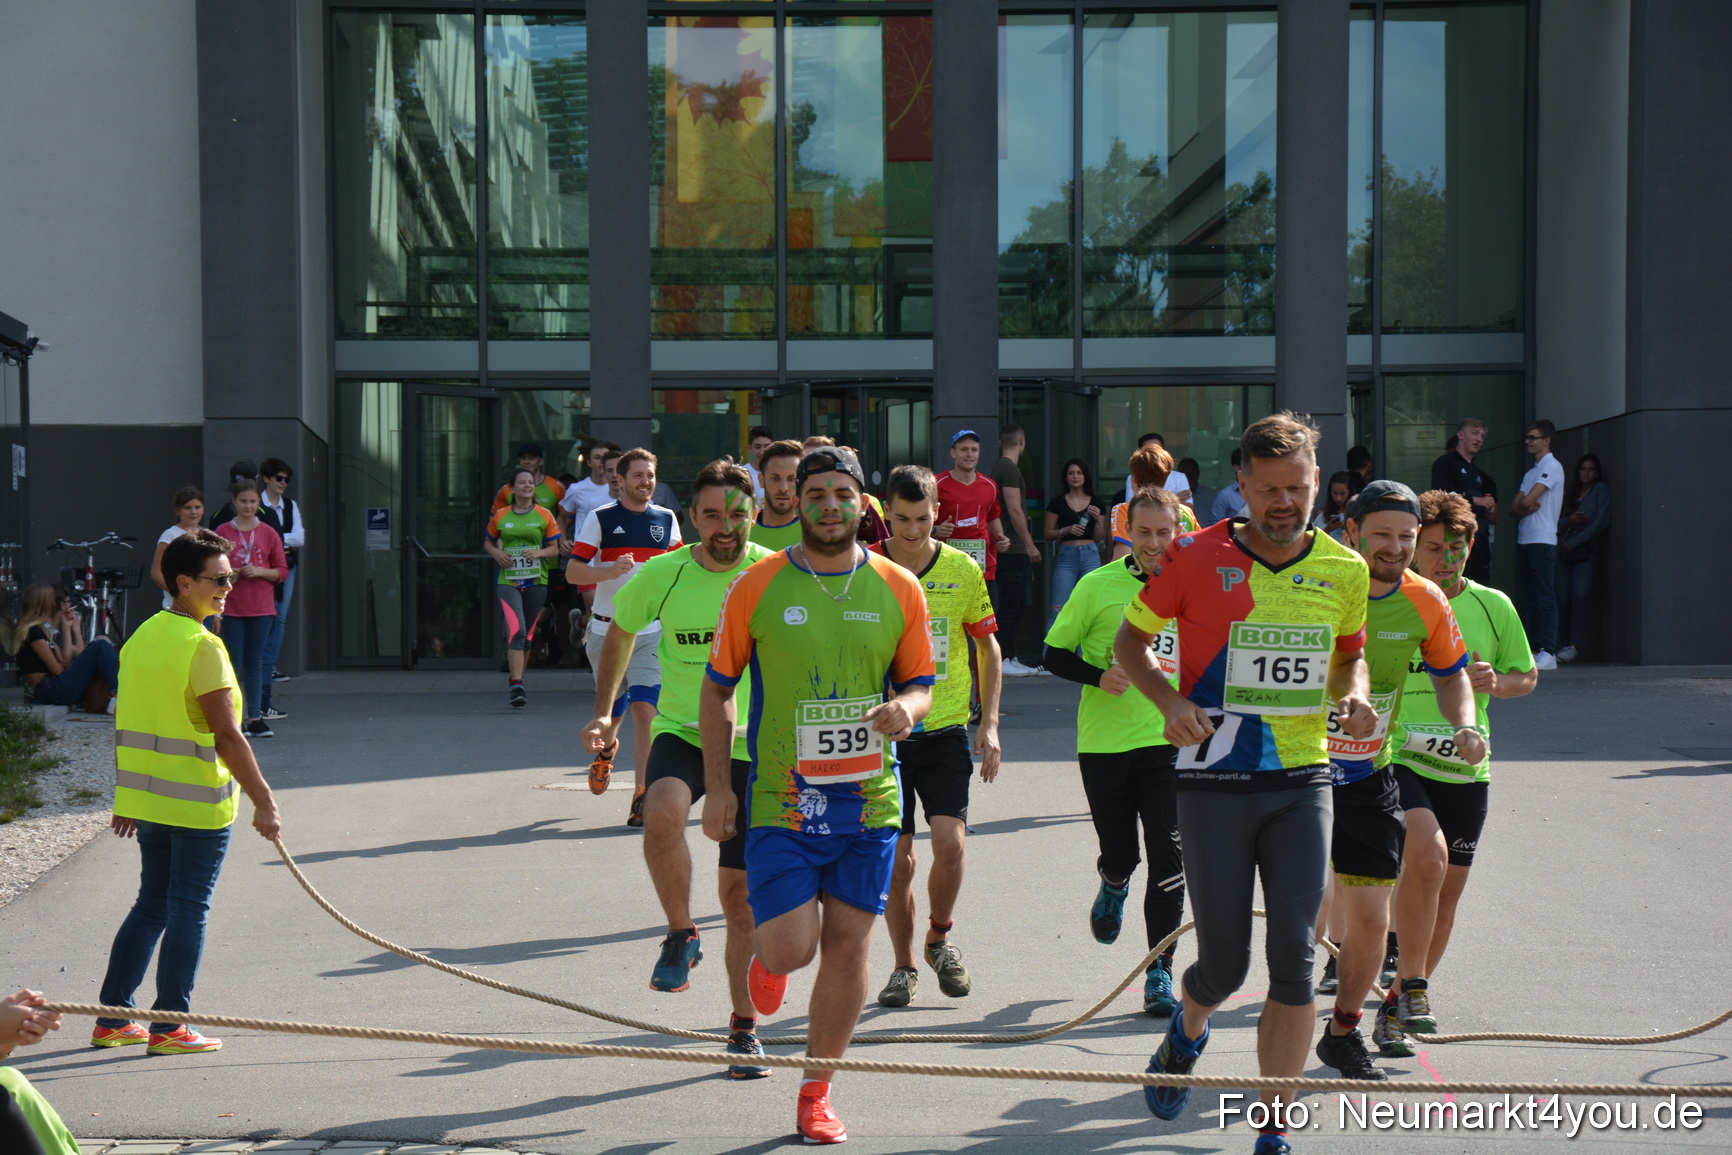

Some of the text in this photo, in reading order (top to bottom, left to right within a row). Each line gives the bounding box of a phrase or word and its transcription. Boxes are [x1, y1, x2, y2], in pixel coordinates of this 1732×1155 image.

[843, 611, 880, 622] BOCK
[1239, 627, 1325, 648] BOCK
[1377, 631, 1408, 640] BOCK
[1252, 656, 1310, 683] 165
[1235, 689, 1281, 703] FRANK
[818, 727, 868, 754] 539
[1412, 753, 1462, 772] Marianne
